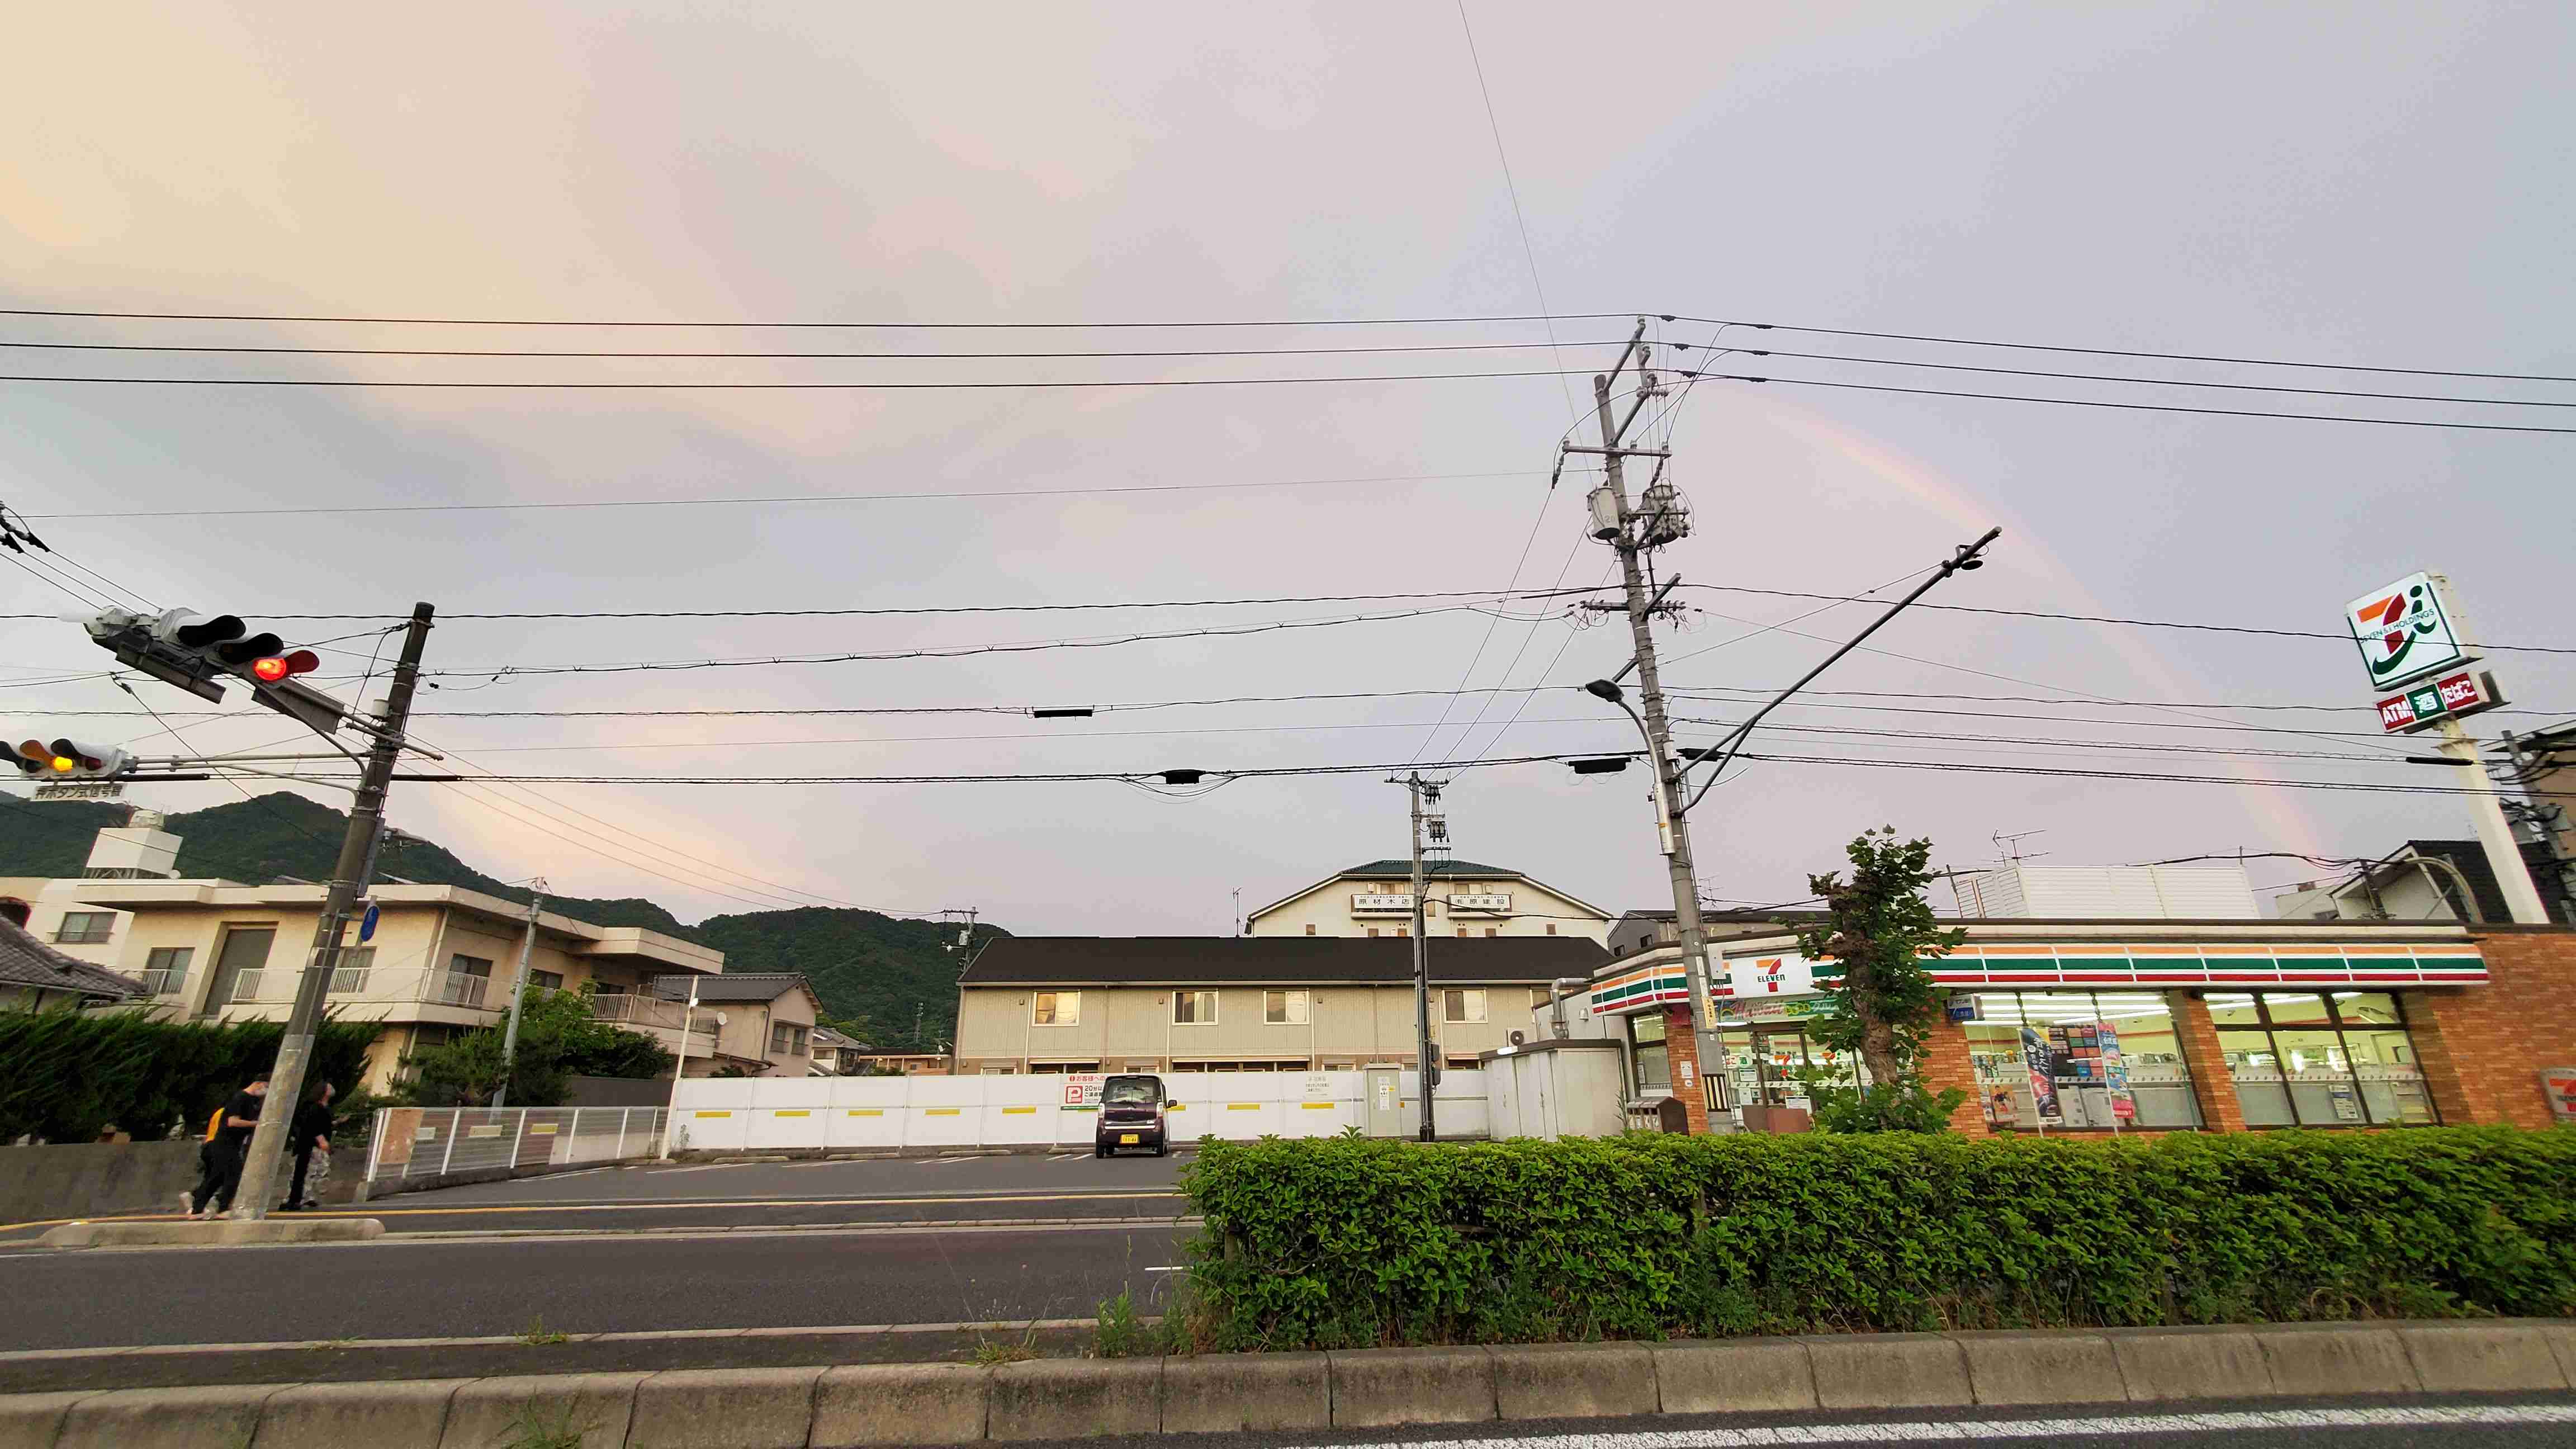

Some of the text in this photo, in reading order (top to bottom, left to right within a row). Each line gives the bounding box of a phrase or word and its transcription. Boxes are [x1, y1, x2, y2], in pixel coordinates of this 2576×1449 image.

[2393, 608, 2434, 630] HOLDINGS
[2414, 692, 2438, 713] 酒
[2441, 680, 2476, 704] たばこ
[2382, 700, 2414, 724] ATM
